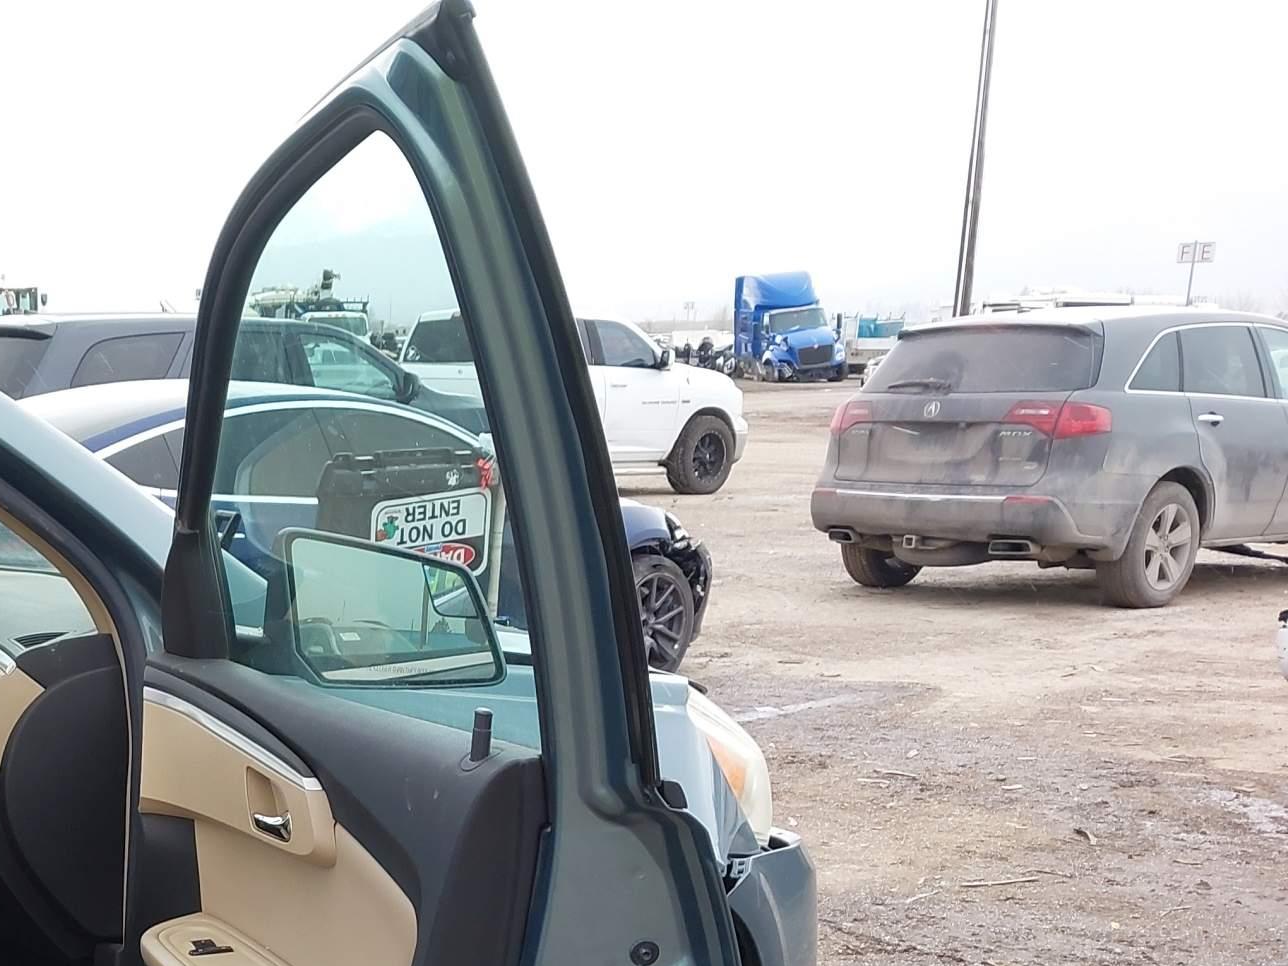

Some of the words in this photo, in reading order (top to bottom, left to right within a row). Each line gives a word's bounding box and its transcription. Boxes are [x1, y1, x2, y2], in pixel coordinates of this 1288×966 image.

[1180, 245, 1192, 261] F
[1201, 244, 1213, 261] E
[404, 499, 461, 524] ENTER
[397, 524, 434, 546] NOT
[441, 518, 467, 537] DO
